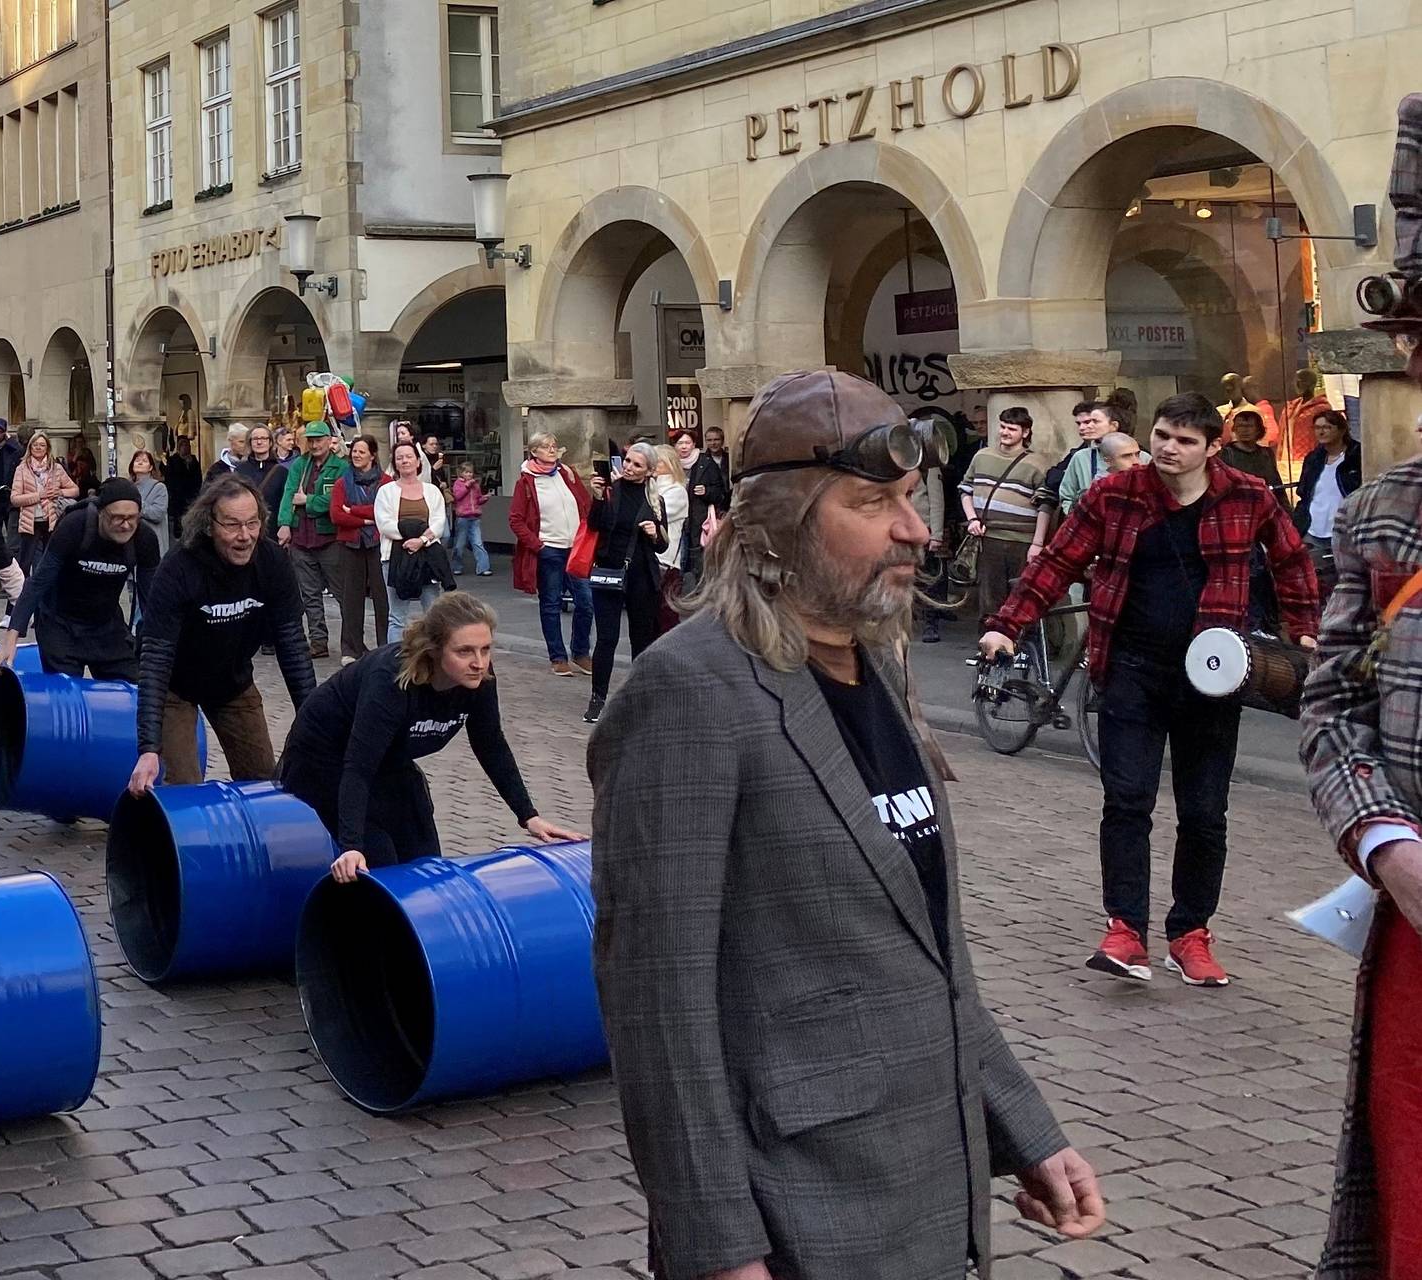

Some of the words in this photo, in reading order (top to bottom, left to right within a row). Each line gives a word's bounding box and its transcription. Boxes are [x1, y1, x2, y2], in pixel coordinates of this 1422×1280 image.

[745, 42, 1080, 162] PETZHOLD
[151, 244, 189, 279] FOTO
[190, 226, 264, 270] ERHARDT
[680, 328, 705, 346] OM
[1110, 326, 1187, 343] XXL-POSTER
